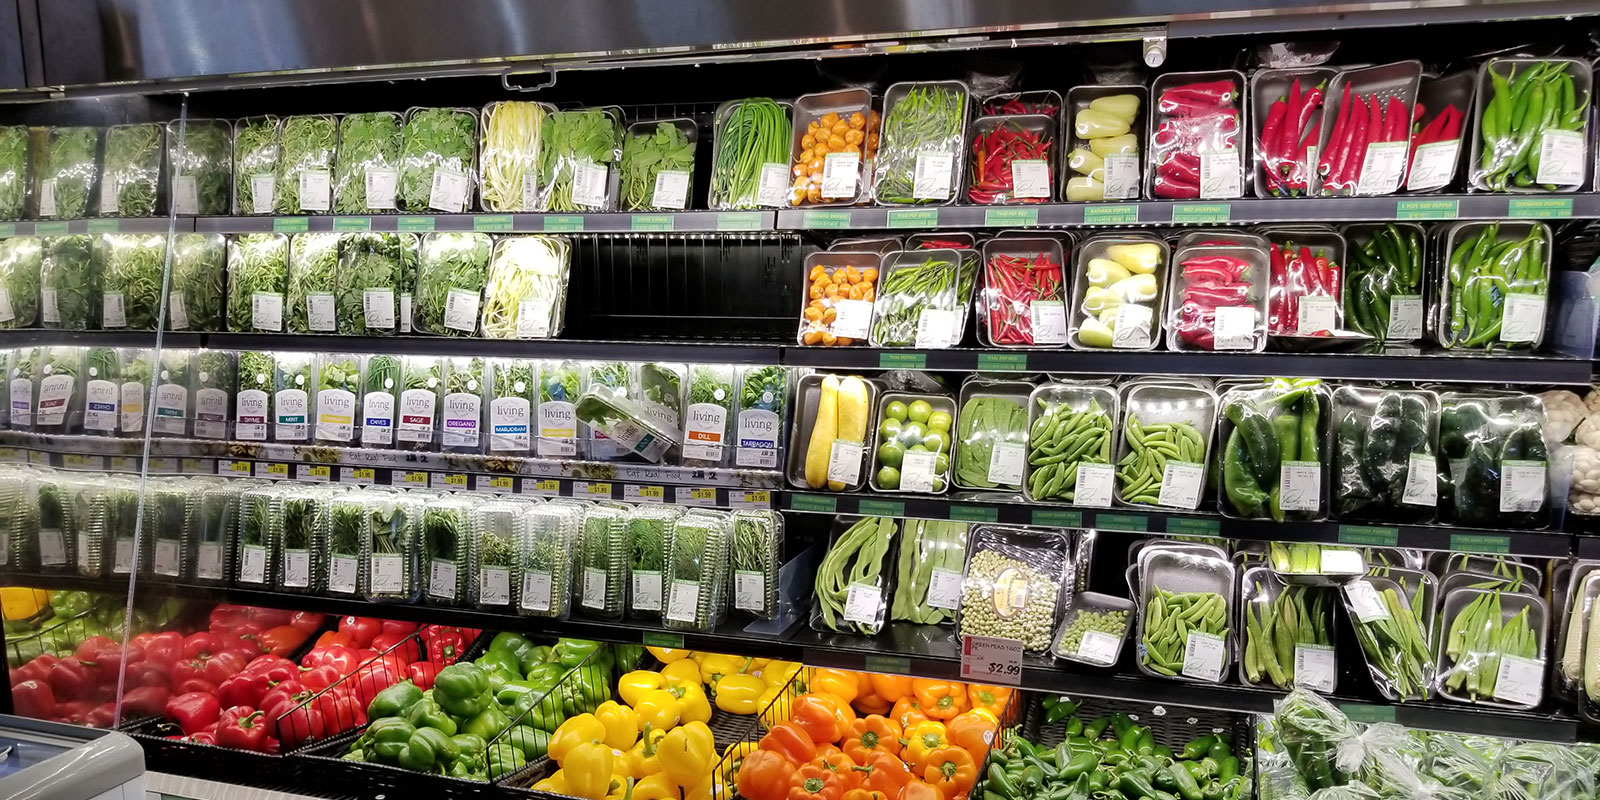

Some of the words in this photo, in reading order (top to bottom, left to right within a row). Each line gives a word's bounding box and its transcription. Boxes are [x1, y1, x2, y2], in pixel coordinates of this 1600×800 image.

[242, 397, 263, 409] living
[280, 397, 303, 408] living
[324, 395, 350, 409] living
[369, 400, 390, 411] living
[406, 396, 430, 409] living
[449, 400, 474, 412] living
[497, 405, 524, 417] living
[544, 408, 571, 420] living
[646, 406, 672, 423] living
[693, 410, 720, 425] living
[448, 420, 476, 428] OREGANO
[743, 417, 772, 432] living
[617, 425, 639, 442] living
[349, 451, 361, 461] Eat
[382, 454, 397, 463] Food
[626, 467, 640, 478] Eat
[666, 469, 682, 481] Food
[988, 661, 1020, 676] $2.99
